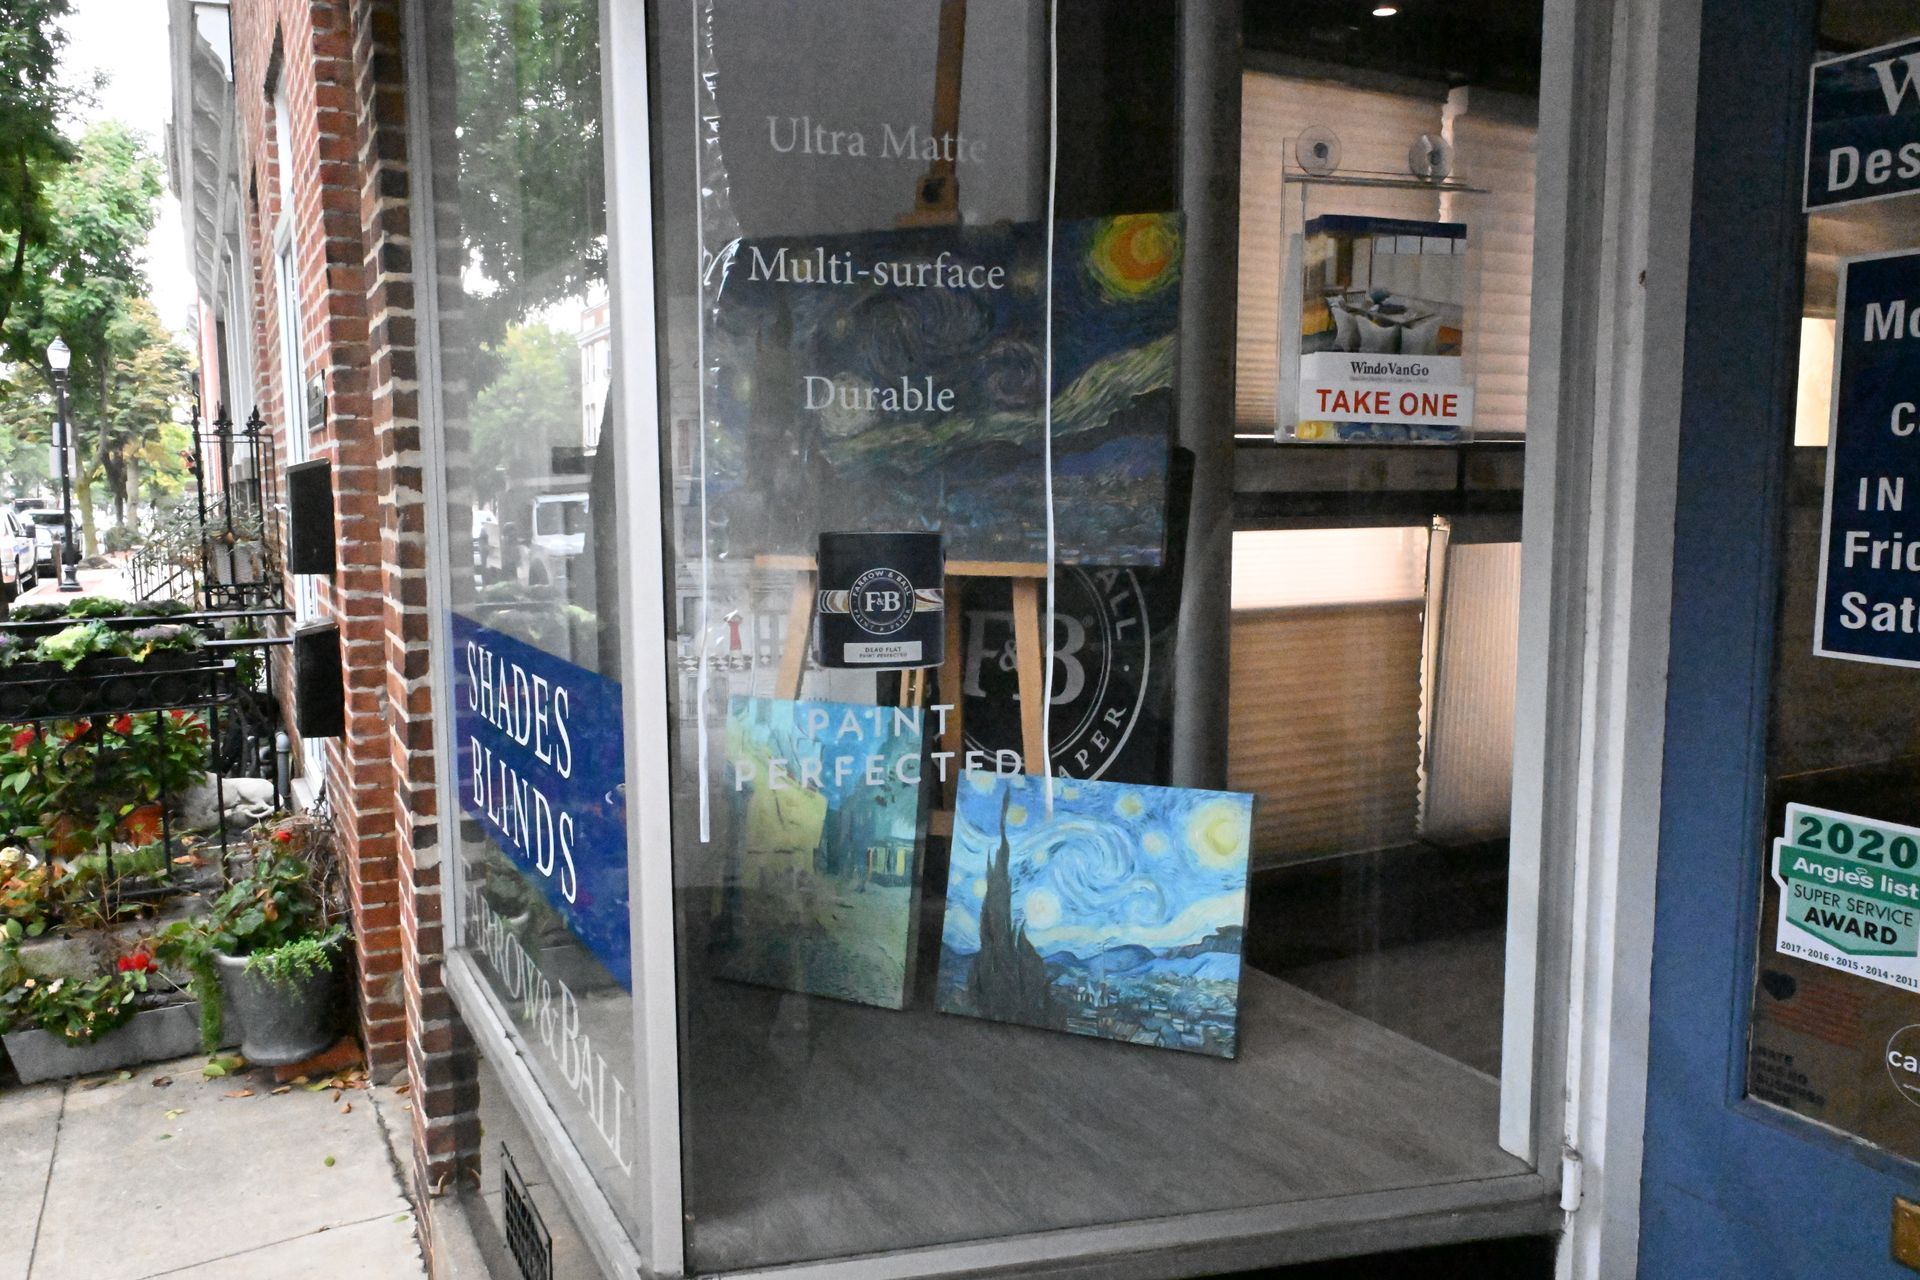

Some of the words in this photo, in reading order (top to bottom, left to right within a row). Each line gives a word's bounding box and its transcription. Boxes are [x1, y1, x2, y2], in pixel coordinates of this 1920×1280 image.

[766, 116, 866, 157] Ultra
[880, 123, 987, 163] Matte
[1827, 142, 1920, 192] Des
[748, 246, 1005, 290] Multi-surface
[1350, 361, 1429, 376] WindoVanGo
[803, 375, 955, 412] Durable
[1316, 389, 1390, 415] TAKE
[1400, 392, 1458, 417] ONE
[1858, 477, 1904, 511] IN
[852, 570, 884, 597] FARROW
[895, 576, 912, 597] BALL
[864, 591, 901, 612] F&B
[1096, 567, 1137, 641] ALL
[1840, 591, 1920, 634] Sat
[467, 640, 572, 780] SHADES
[807, 704, 955, 742] PAINT
[1057, 706, 1128, 780] APER
[734, 749, 1023, 793] PERFECTED
[471, 735, 577, 905] BLINDS
[1797, 816, 1919, 869] 2020
[1793, 884, 1841, 909] SUPER
[1846, 897, 1913, 928] SERVICE
[1881, 874, 1919, 901] list
[1804, 906, 1898, 945] AWARD
[1781, 940, 1802, 953] 2017
[1808, 948, 1829, 962] 2016
[1836, 956, 1858, 970] 2015
[1866, 965, 1888, 979] 2014
[1895, 974, 1918, 988] 2011
[540, 978, 558, 1062] &
[559, 979, 633, 1178] BALL
